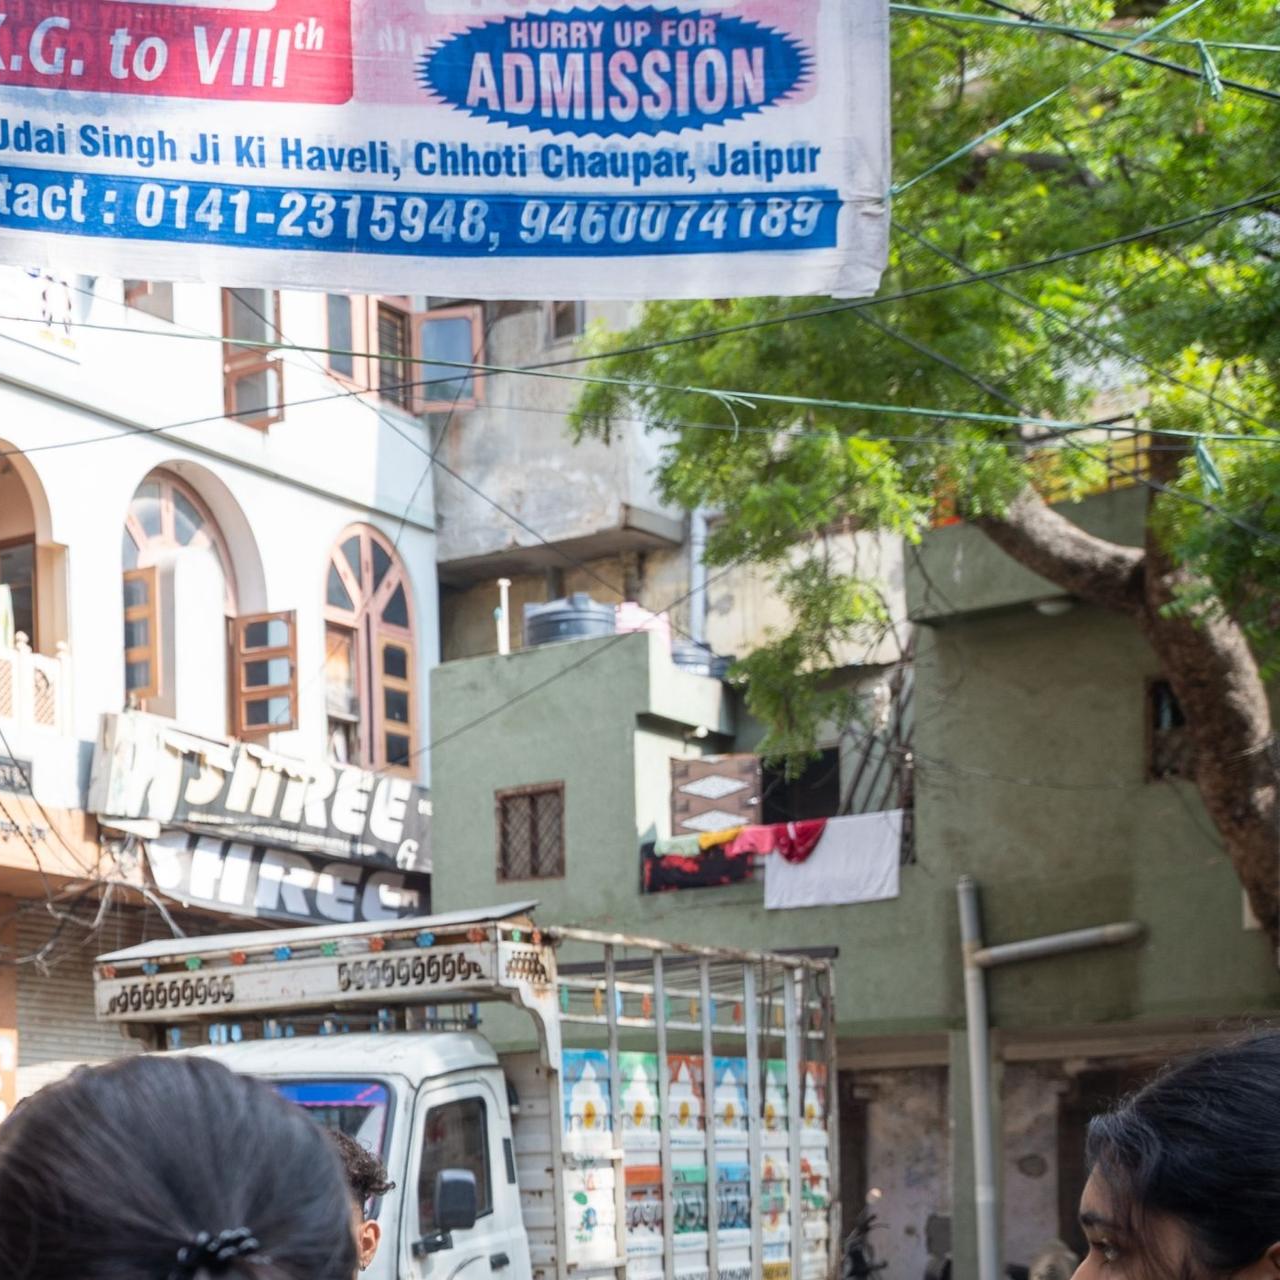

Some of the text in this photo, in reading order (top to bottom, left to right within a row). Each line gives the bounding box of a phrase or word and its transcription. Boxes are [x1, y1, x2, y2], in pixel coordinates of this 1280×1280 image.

[109, 28, 168, 81] to
[510, 18, 717, 49] HURRY UP FOR
[465, 46, 765, 122] ADMISSION
[80, 123, 177, 168] Singh
[189, 133, 220, 166] Ji
[235, 135, 266, 168] Ki
[281, 137, 401, 181] Haveli,
[413, 141, 527, 178] Chhoti
[541, 142, 696, 186] Chaupar,
[707, 142, 822, 183] Jaipur
[135, 183, 500, 251] 0141-2315948,
[519, 196, 824, 244] 9460074189
